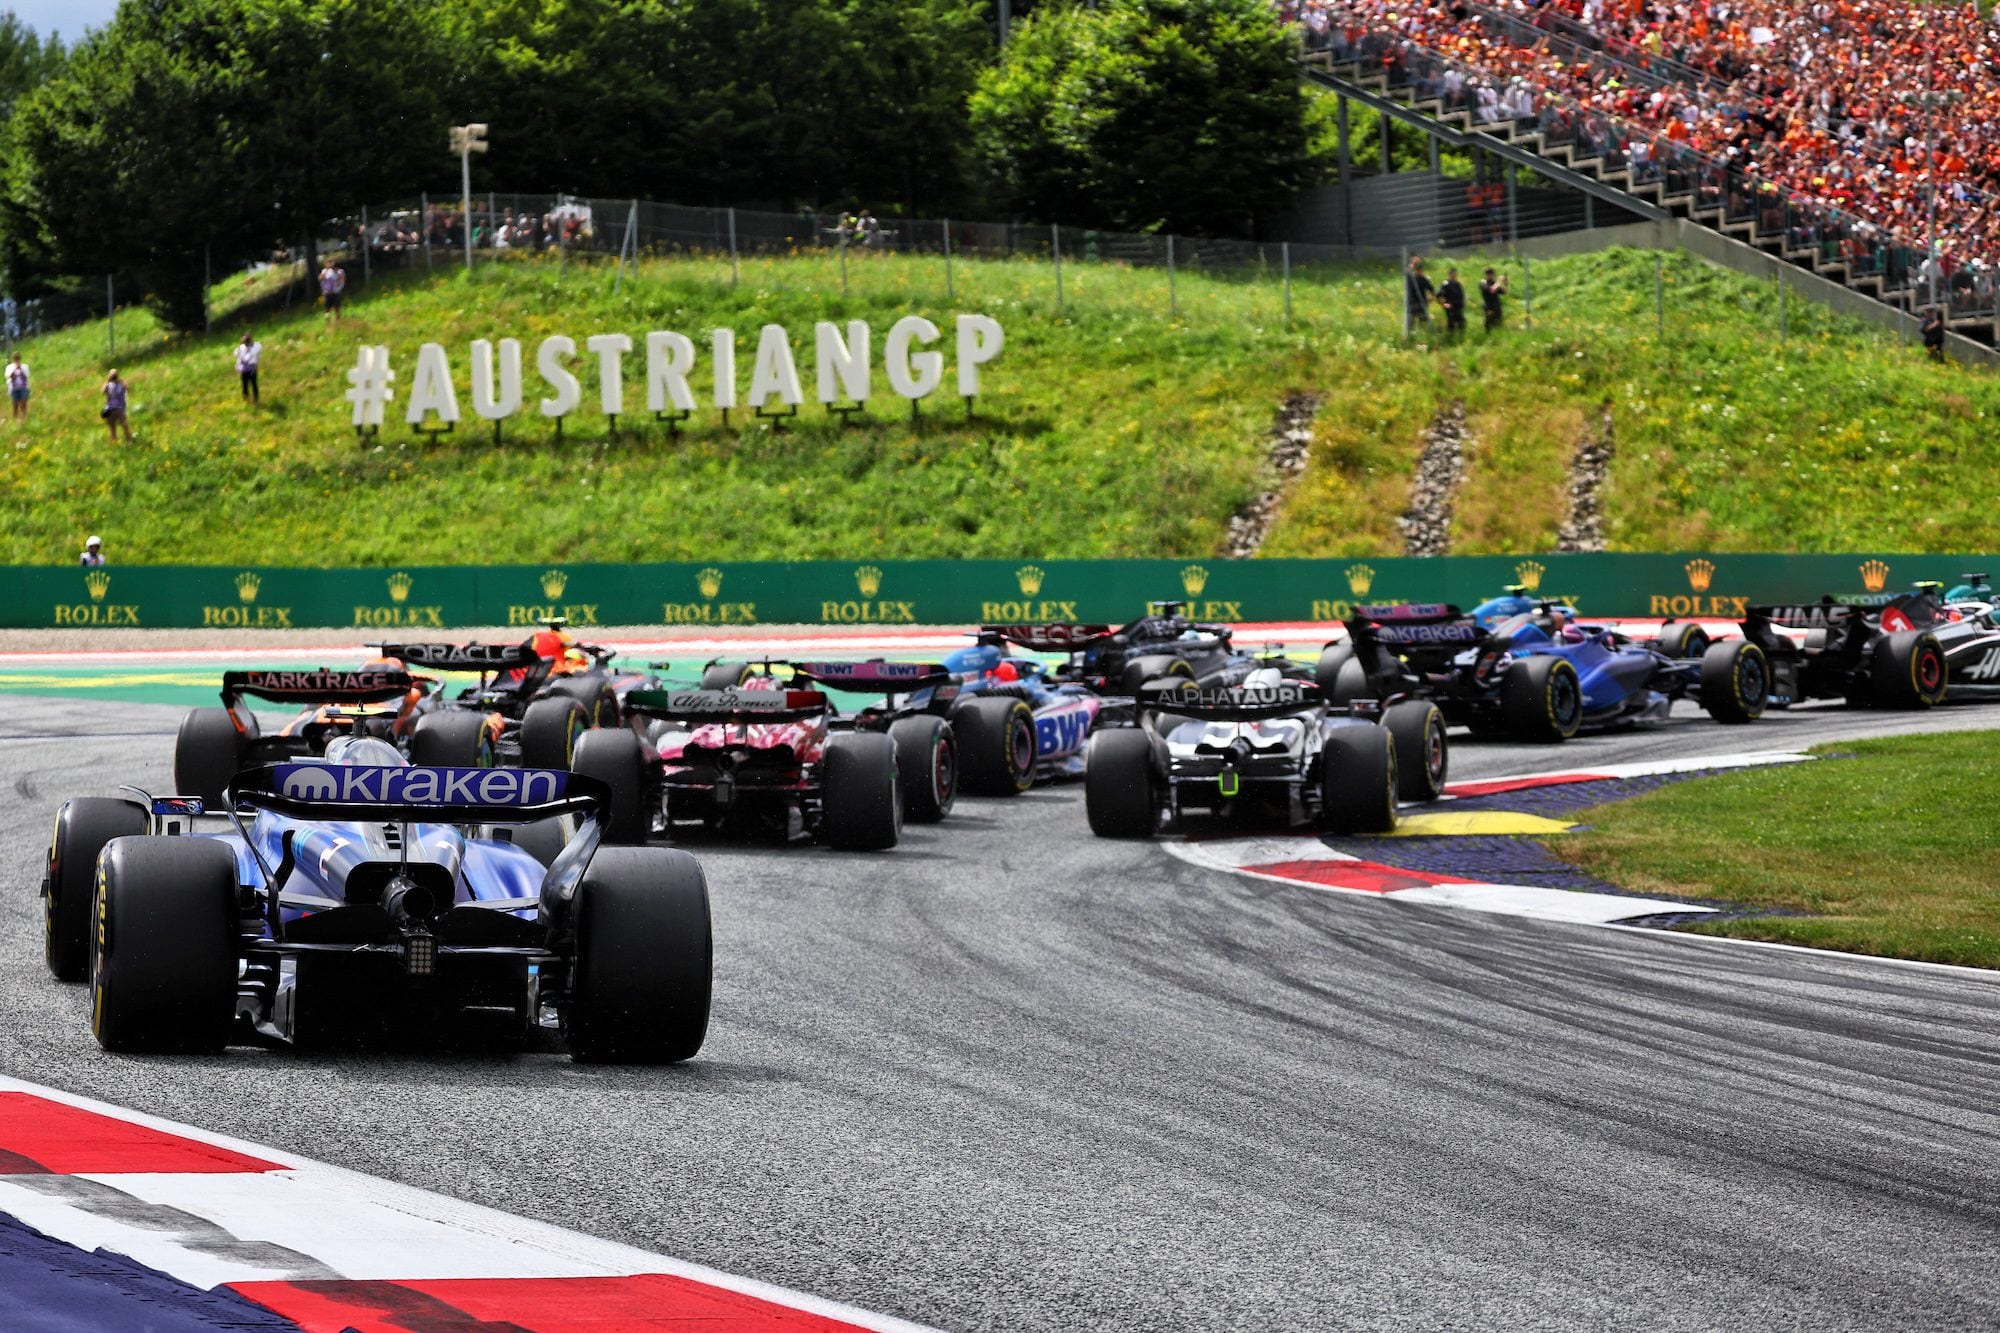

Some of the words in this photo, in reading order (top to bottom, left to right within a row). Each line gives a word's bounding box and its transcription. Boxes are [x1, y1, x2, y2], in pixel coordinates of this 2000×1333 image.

[346, 314, 1004, 425] #AUSTRIANGP
[54, 604, 141, 625] ROLEX
[664, 602, 757, 622] ROLEX
[822, 601, 915, 621] ROLEX
[982, 601, 1077, 621] ROLEX
[1146, 601, 1243, 621] RLEX
[1650, 594, 1750, 616] ROLEX
[202, 606, 292, 627] ROLEX
[353, 605, 443, 626] ROLEX
[404, 646, 519, 663] ORACLE
[823, 664, 853, 676] BWT
[888, 664, 918, 676] BWT
[250, 672, 388, 690] DARKTRACE
[673, 694, 714, 709] Alfa
[717, 694, 782, 709] Romeo
[1158, 688, 1304, 704] ALPHATAURI
[1036, 710, 1089, 755] BWT
